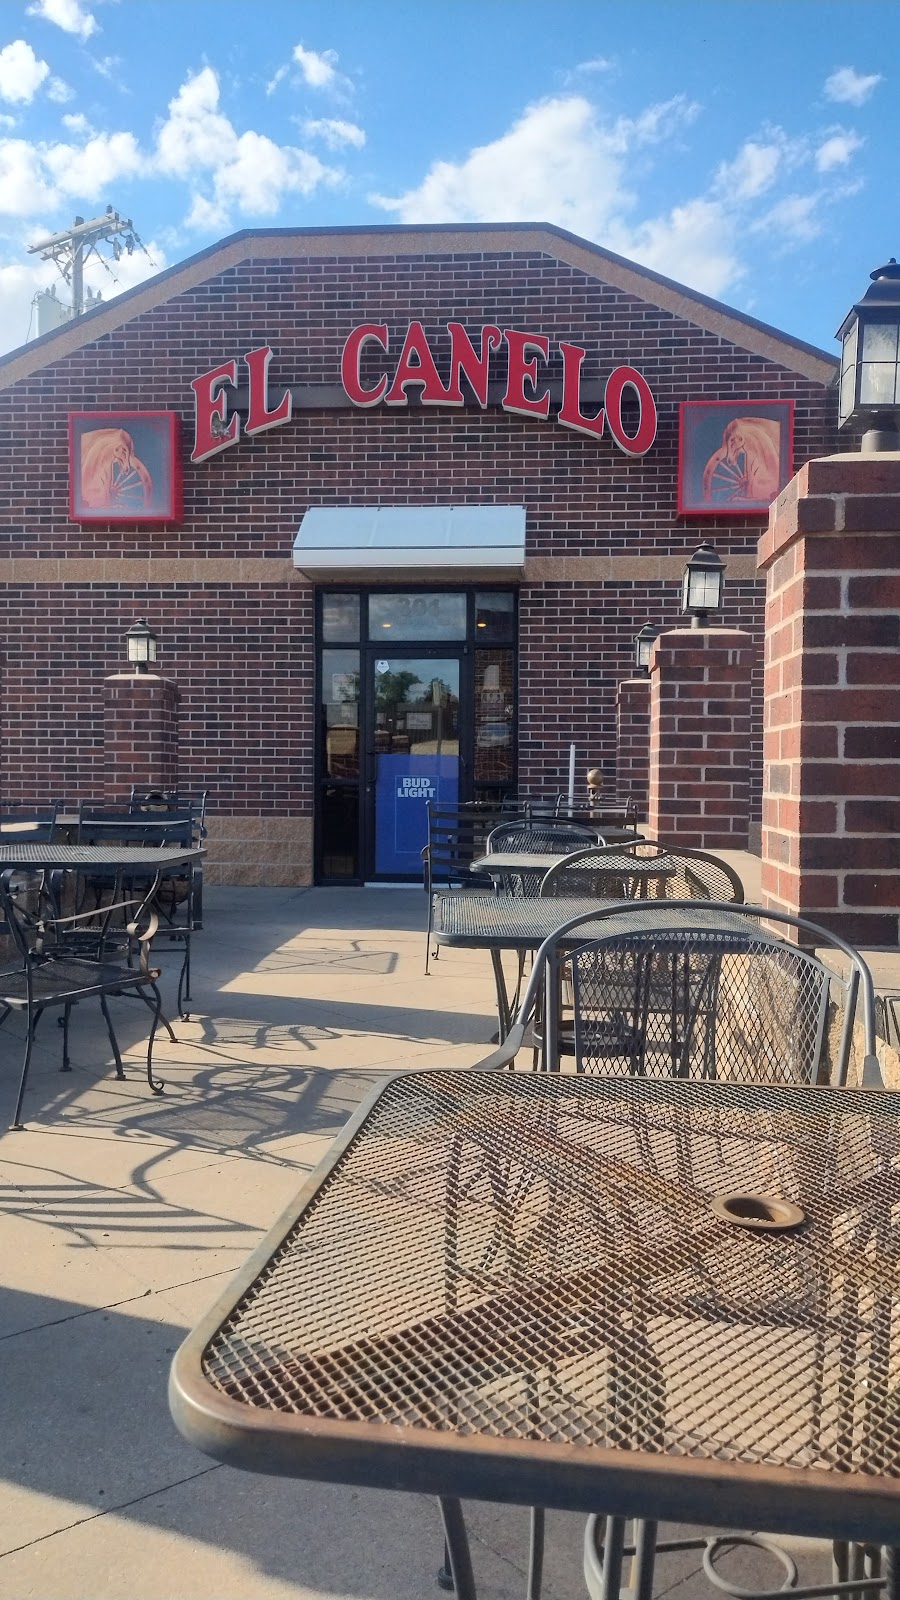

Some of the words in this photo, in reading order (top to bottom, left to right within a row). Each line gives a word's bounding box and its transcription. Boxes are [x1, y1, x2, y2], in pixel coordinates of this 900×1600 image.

[190, 345, 293, 464] EL
[340, 321, 658, 458] CANELO
[402, 777, 431, 788] BUD
[397, 787, 436, 798] LIGHT
